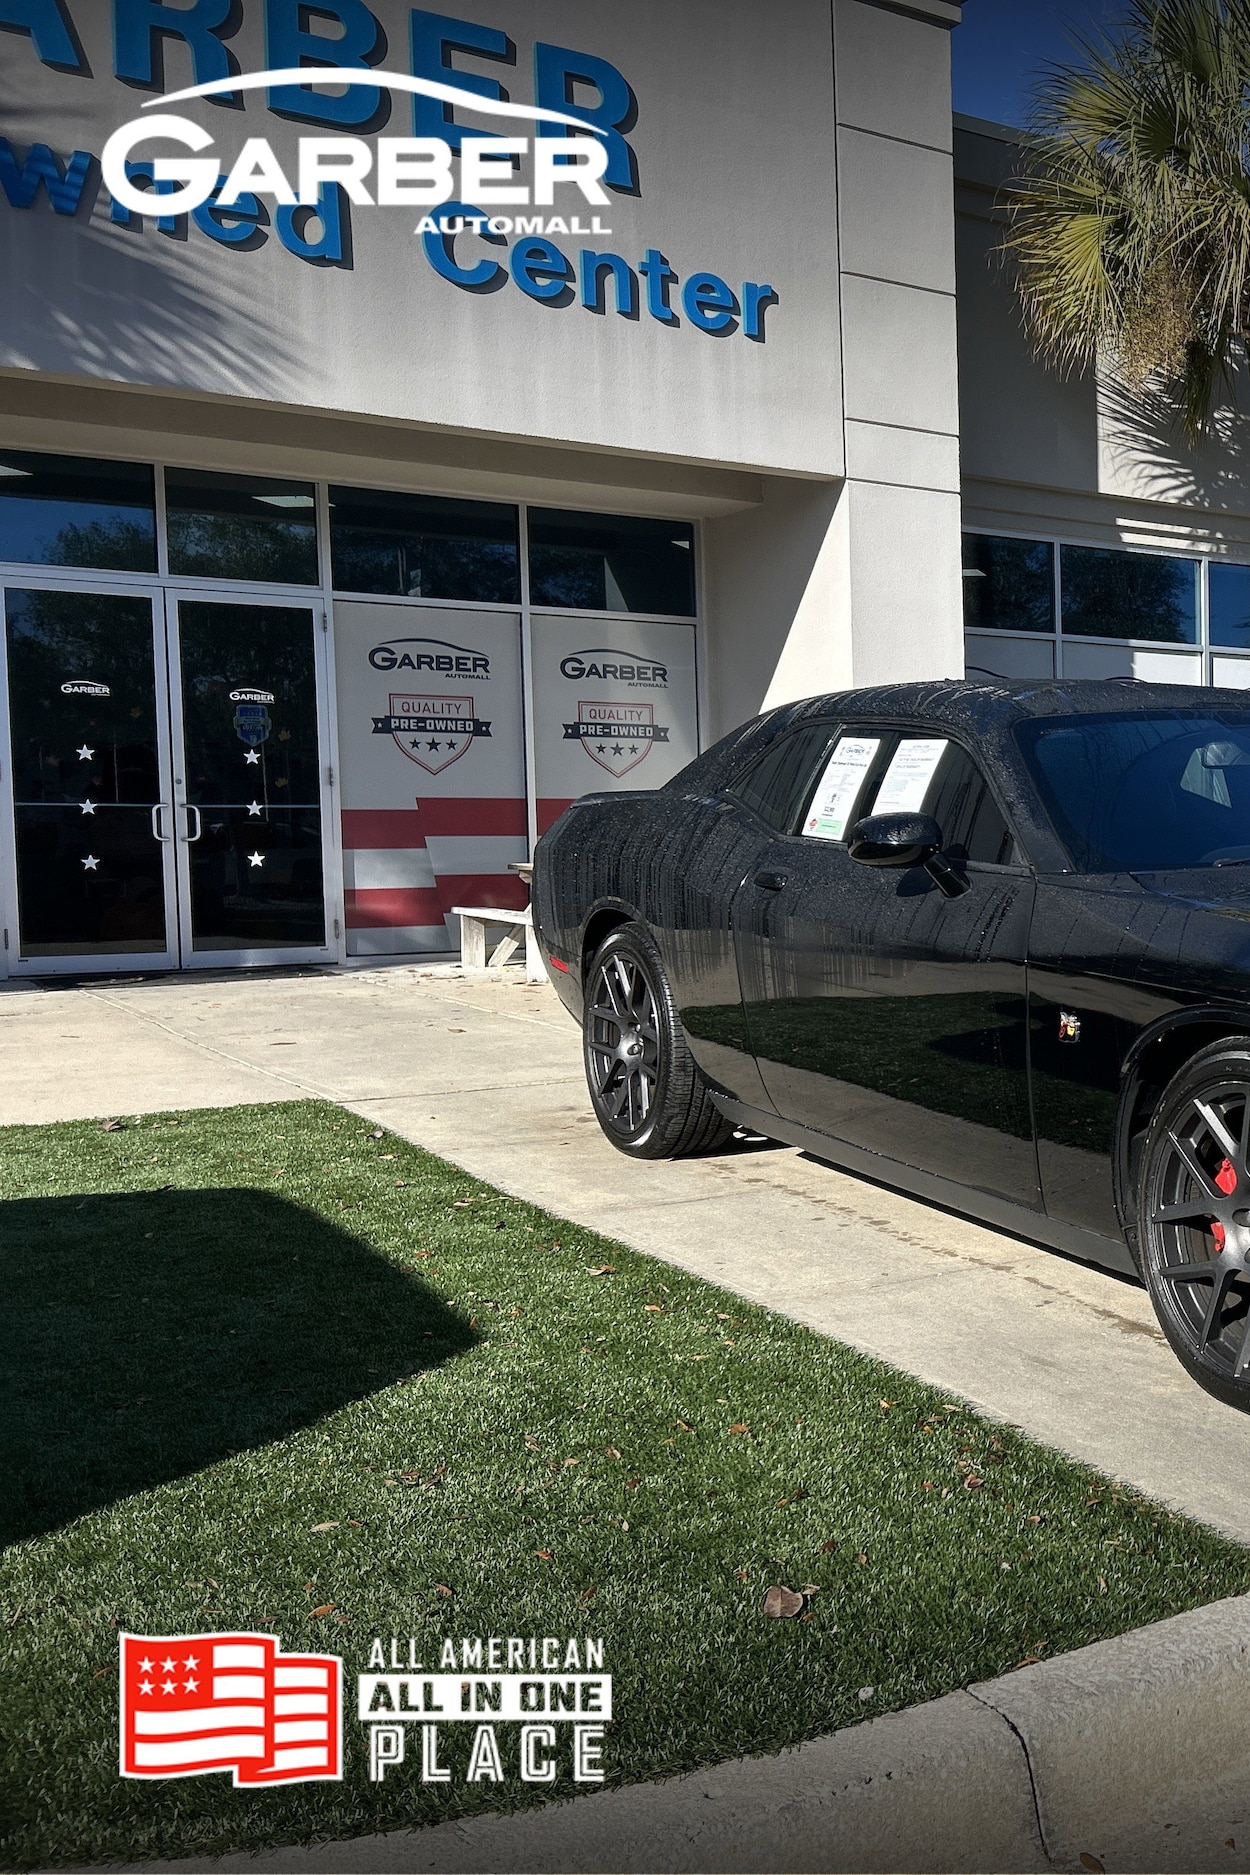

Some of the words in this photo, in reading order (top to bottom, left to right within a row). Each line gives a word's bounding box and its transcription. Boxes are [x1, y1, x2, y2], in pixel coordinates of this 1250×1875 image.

[422, 203, 777, 339] Center
[368, 646, 491, 674] GARBER
[559, 657, 669, 682] GARBER
[401, 701, 463, 716] QUALITY
[589, 708, 644, 721] QUALITY
[391, 718, 475, 732] PRE-OWNED
[580, 724, 654, 738] PRE-OWNED
